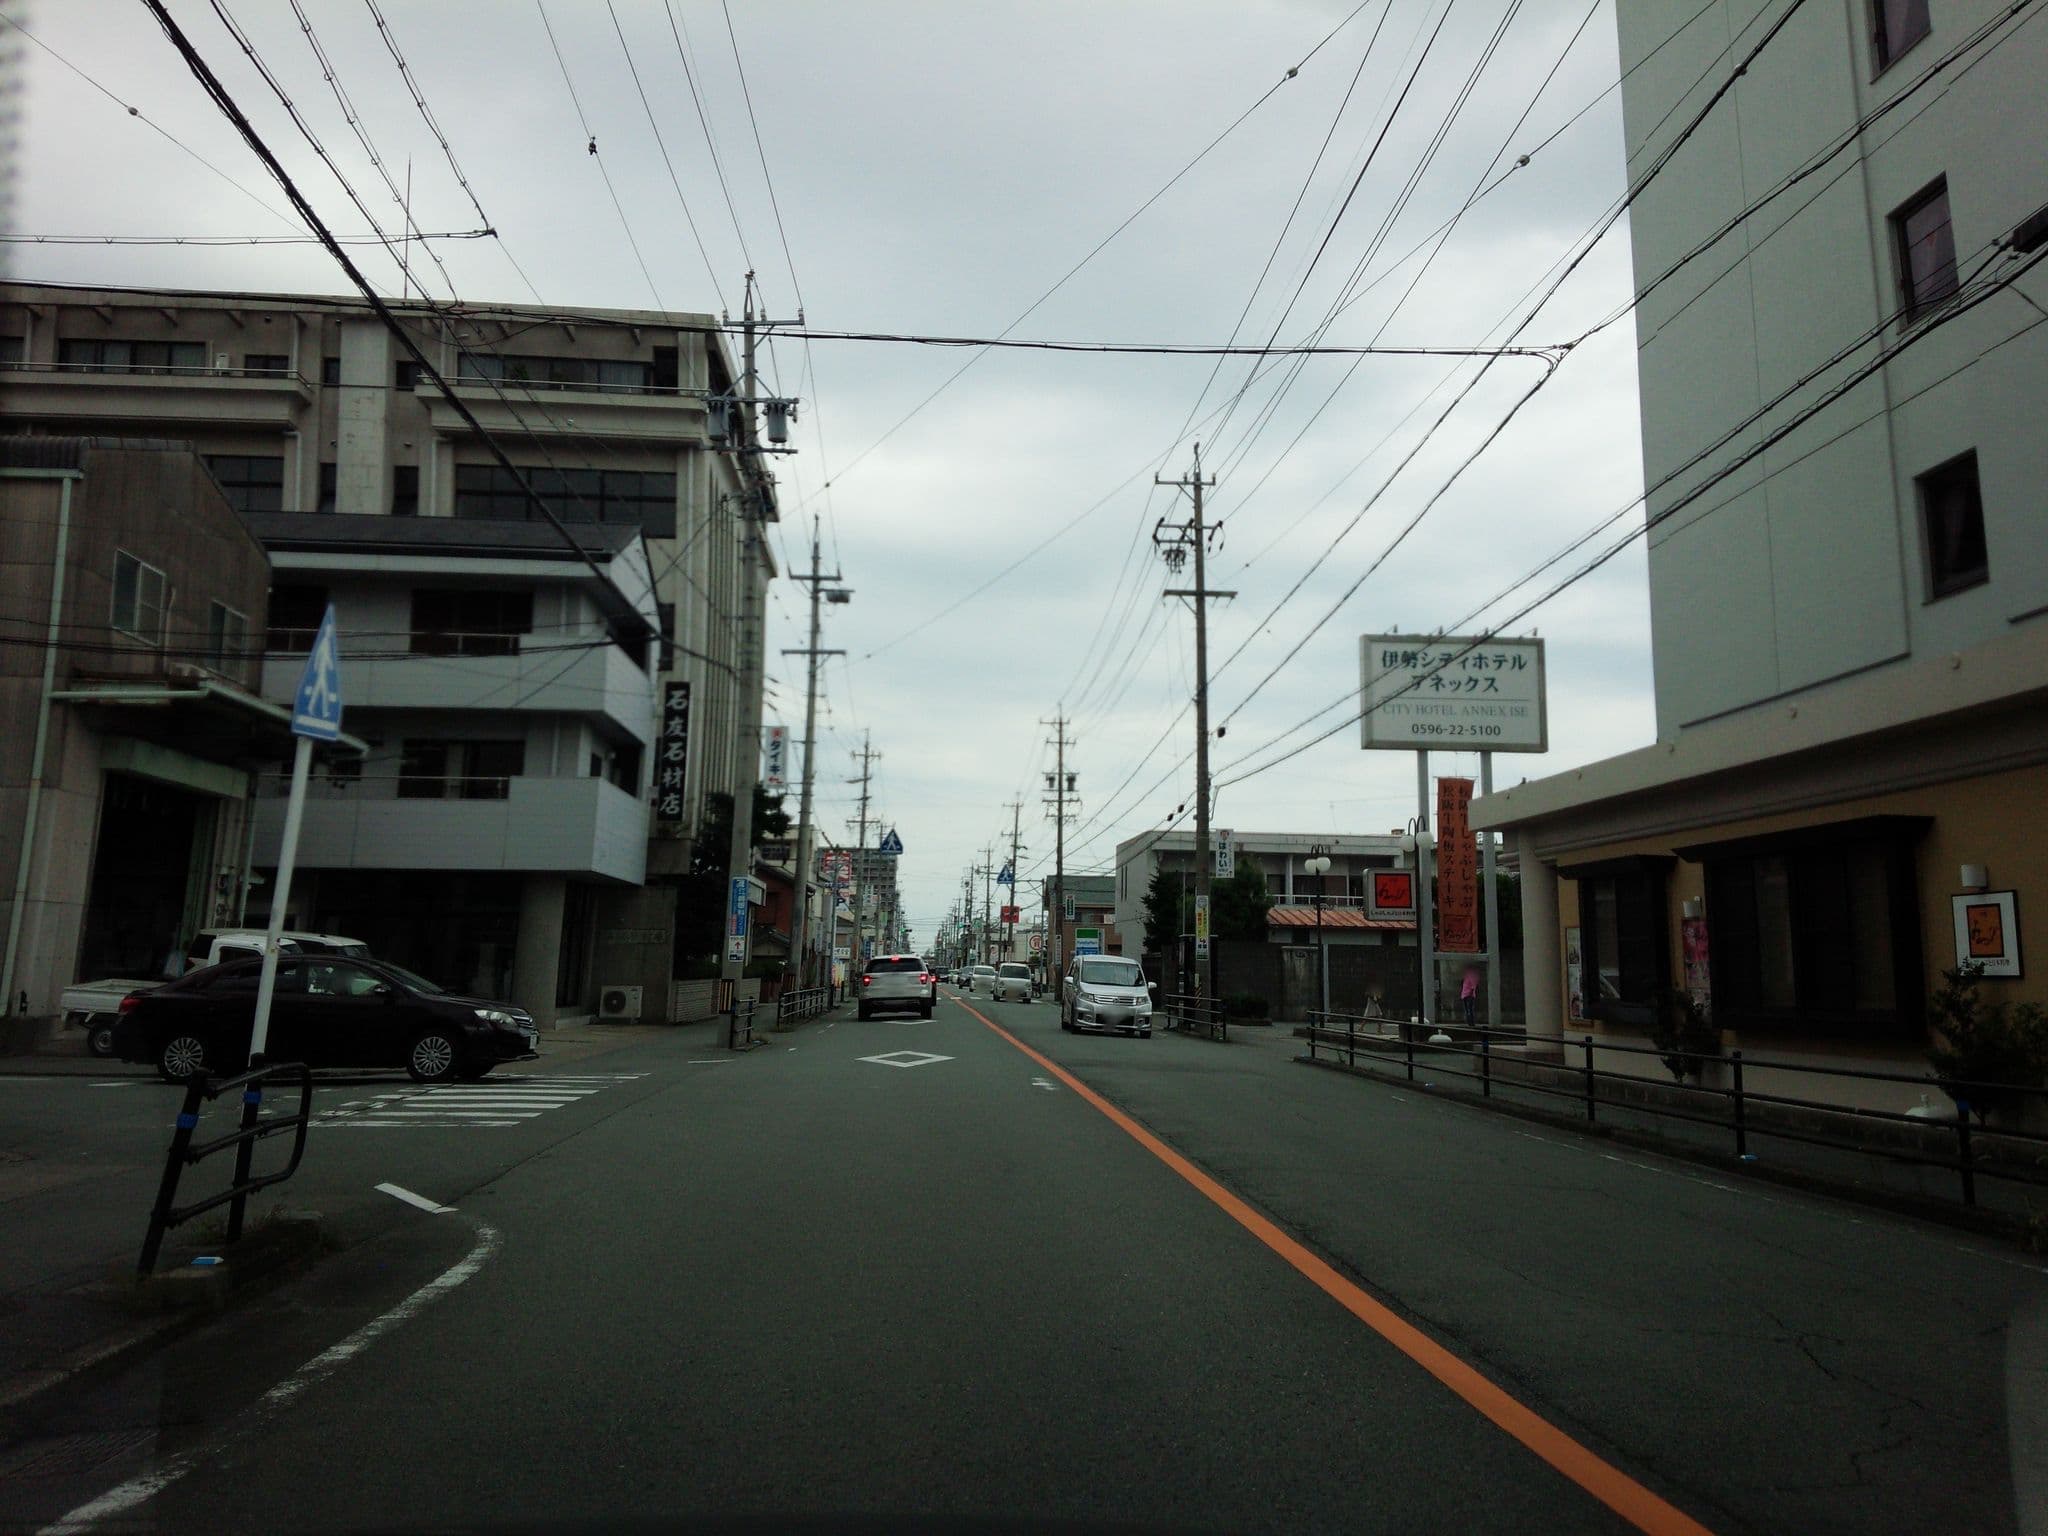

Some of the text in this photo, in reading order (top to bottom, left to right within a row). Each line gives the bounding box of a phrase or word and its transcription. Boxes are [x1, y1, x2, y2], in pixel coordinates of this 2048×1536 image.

[1382, 650, 1528, 671] 伊勢シティホテル
[1411, 675, 1499, 693] アネックス
[1382, 704, 1528, 717] CITY HOTEL ANNEX ISE
[1411, 724, 1501, 736] 0596-22-5100
